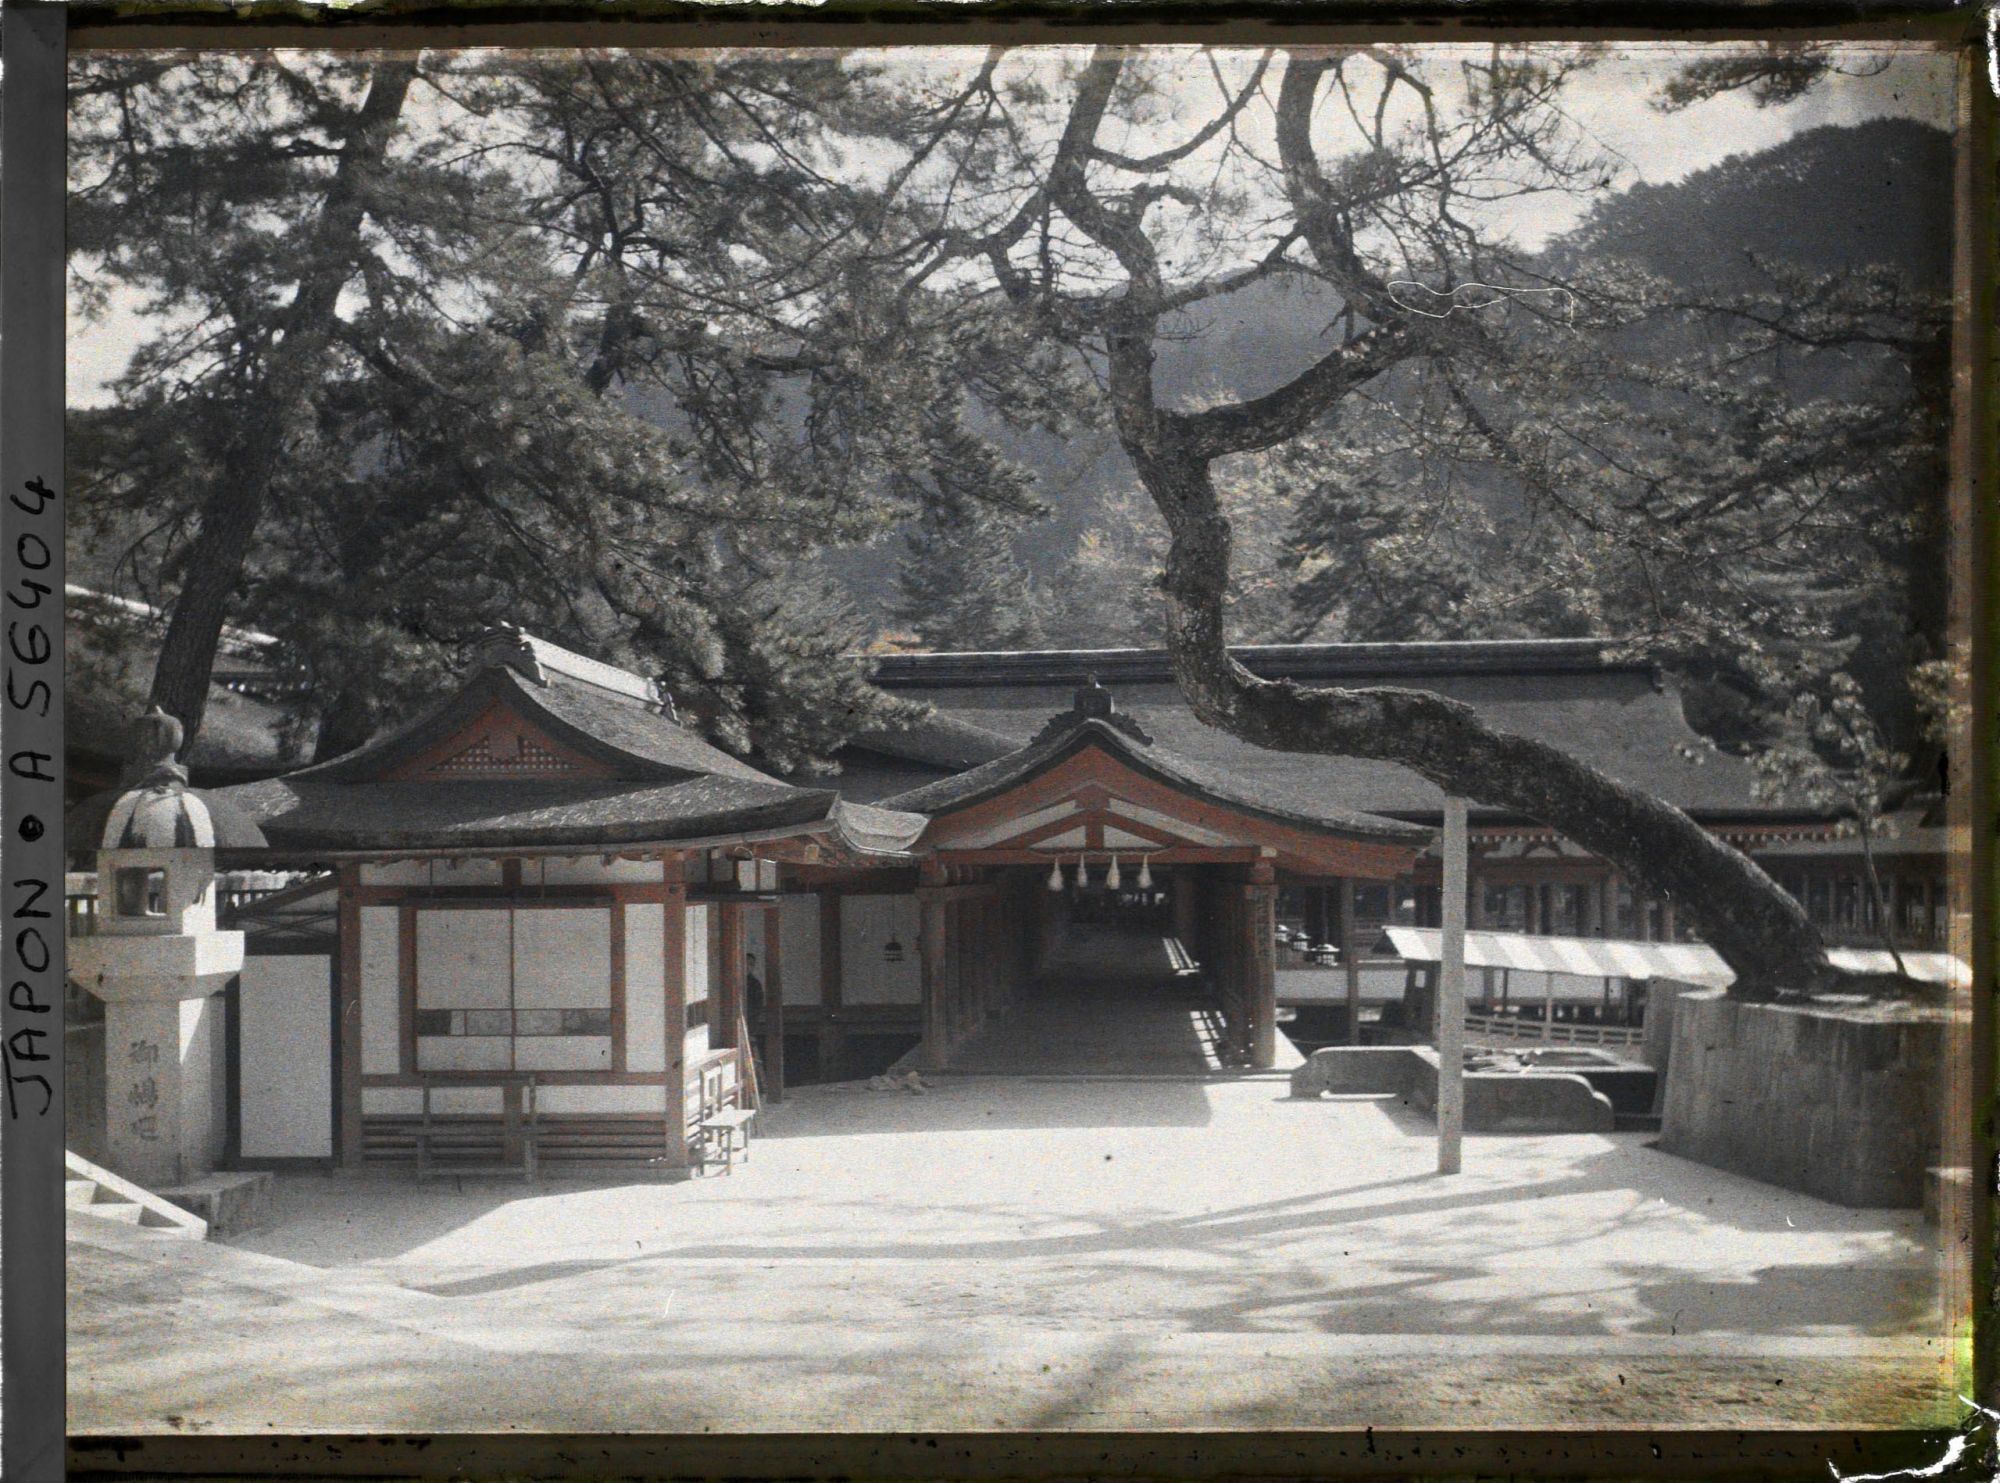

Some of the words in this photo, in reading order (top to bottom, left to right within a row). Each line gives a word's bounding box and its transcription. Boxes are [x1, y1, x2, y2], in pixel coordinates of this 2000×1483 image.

[7, 475, 55, 717] 56404
[8, 751, 55, 782] A
[2, 879, 52, 1119] JAPON
